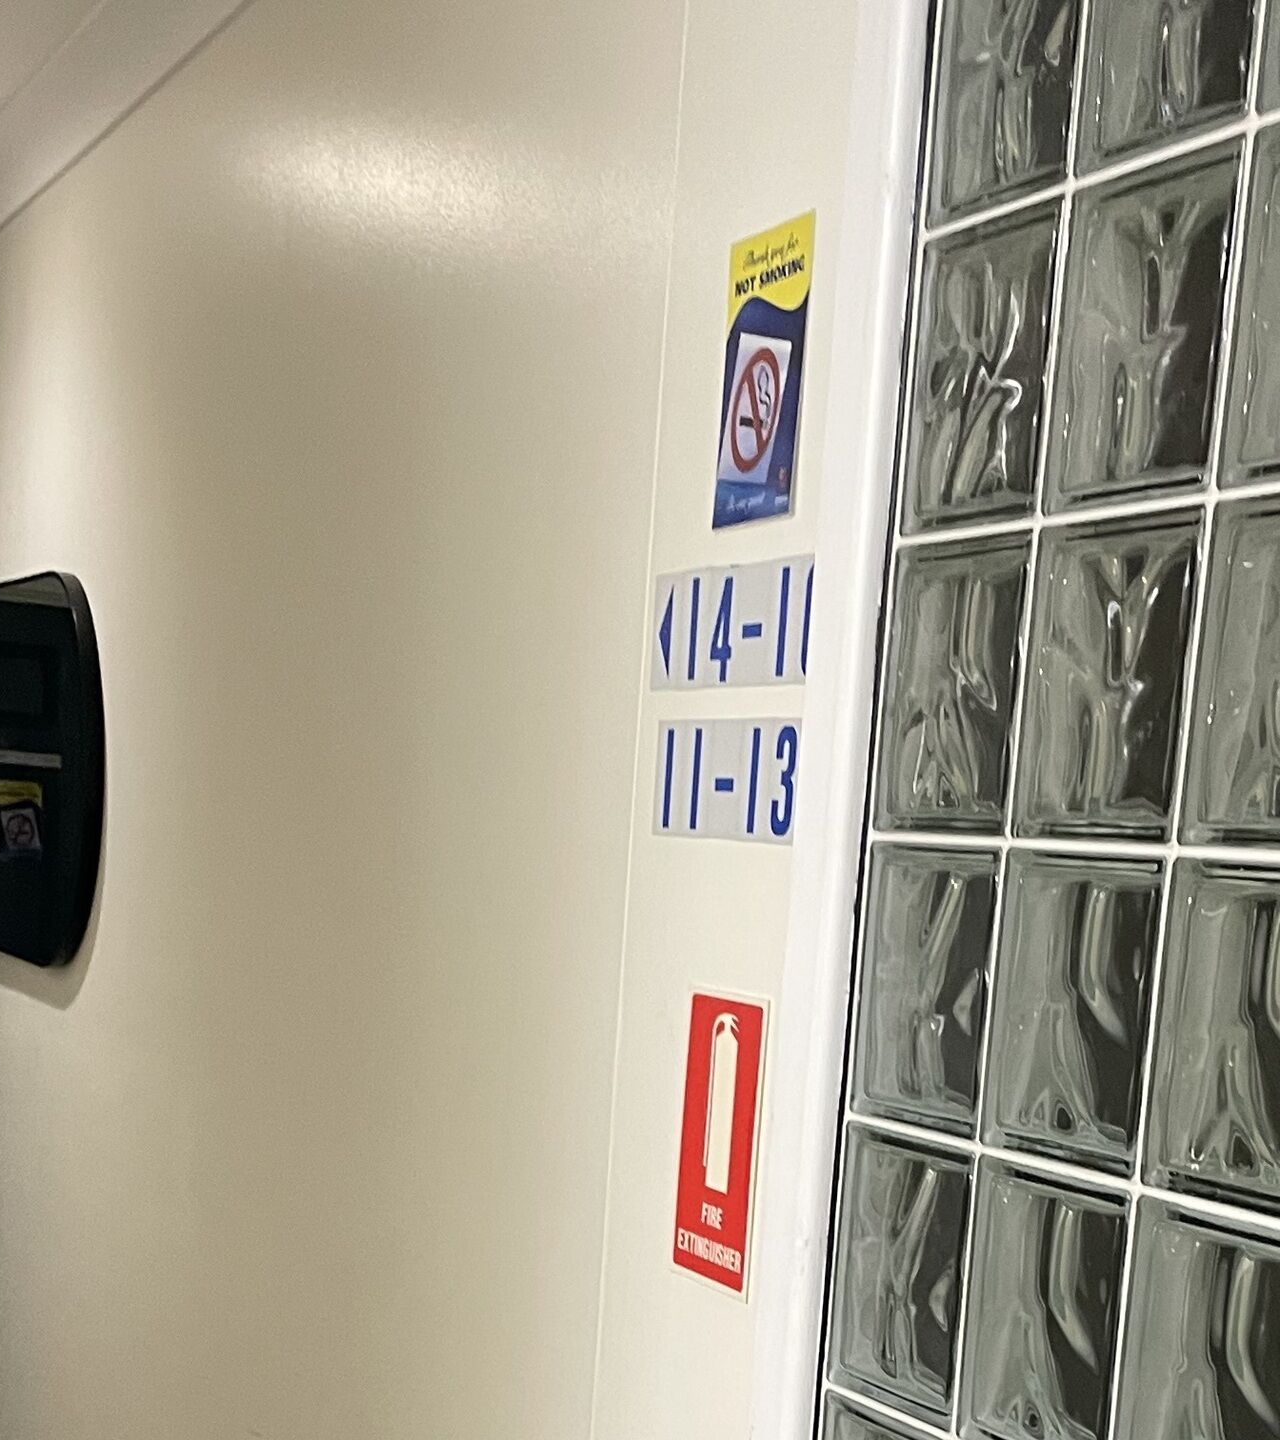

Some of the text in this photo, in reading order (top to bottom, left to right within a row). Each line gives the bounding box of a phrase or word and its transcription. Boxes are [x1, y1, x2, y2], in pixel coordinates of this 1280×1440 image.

[734, 253, 806, 298] NOT SMOKING
[687, 563, 815, 683] 14-1
[662, 725, 798, 837] 11-13
[701, 1201, 724, 1231] FIRE
[677, 1226, 742, 1275] EXTINGUISHER
